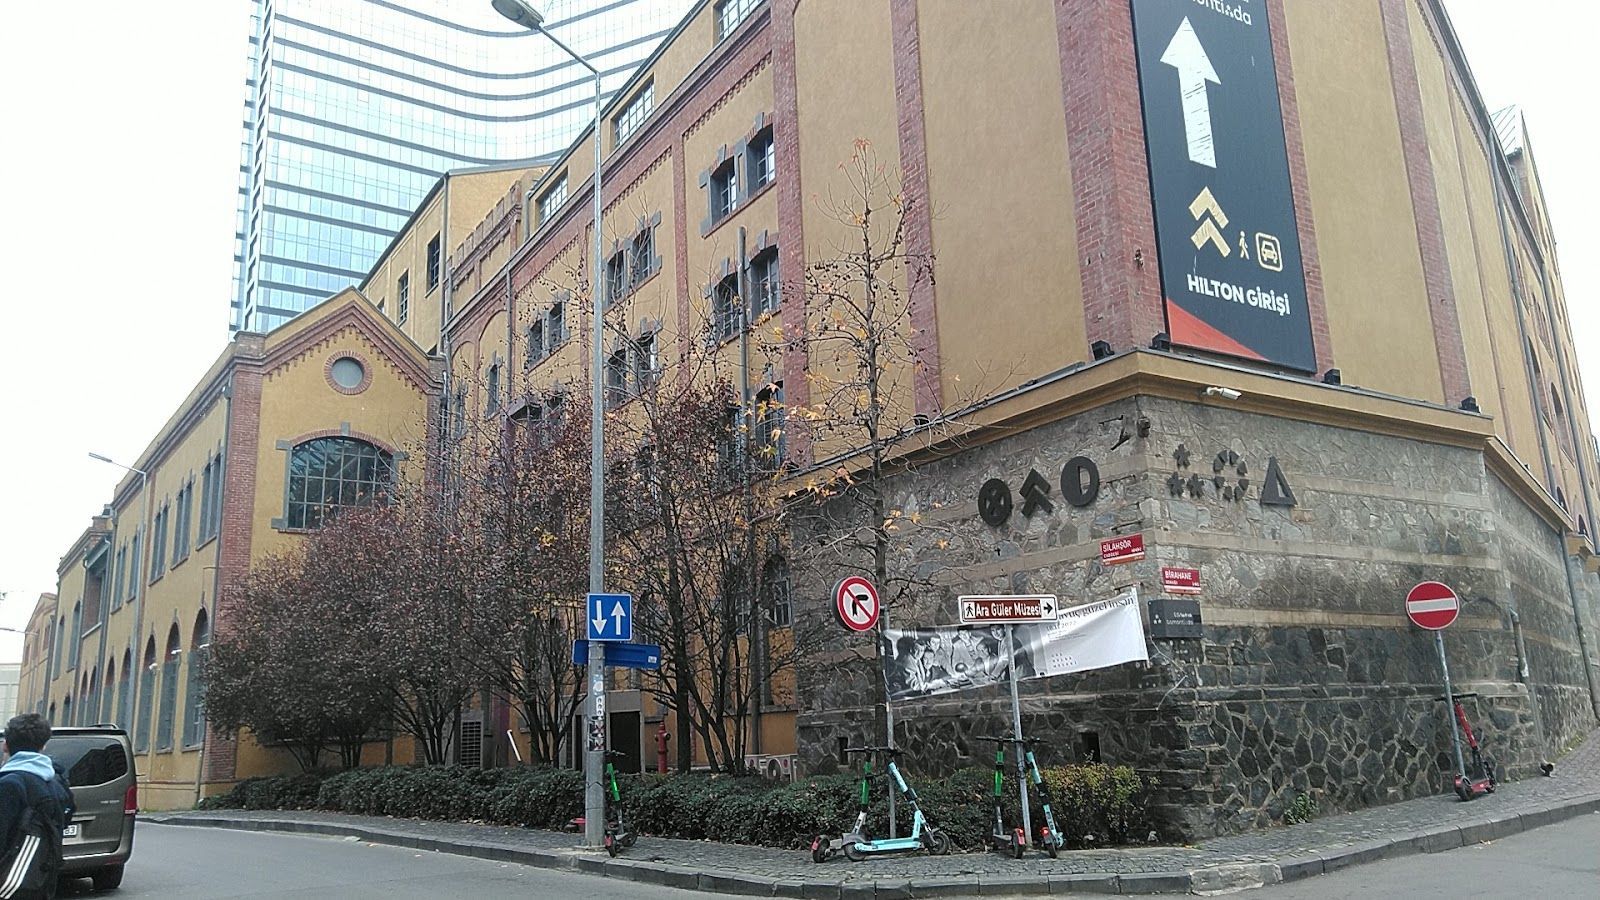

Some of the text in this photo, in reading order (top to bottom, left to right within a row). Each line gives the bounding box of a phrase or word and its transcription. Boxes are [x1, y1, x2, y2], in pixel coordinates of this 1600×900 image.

[1187, 274, 1291, 316] HILTON GİRİŞİ
[1103, 540, 1132, 552] SİLAHŞÖR
[1165, 570, 1193, 580] BİRAHANE
[976, 601, 1041, 617] Ara Güler Müzesi
[1082, 601, 1107, 617] güzel
